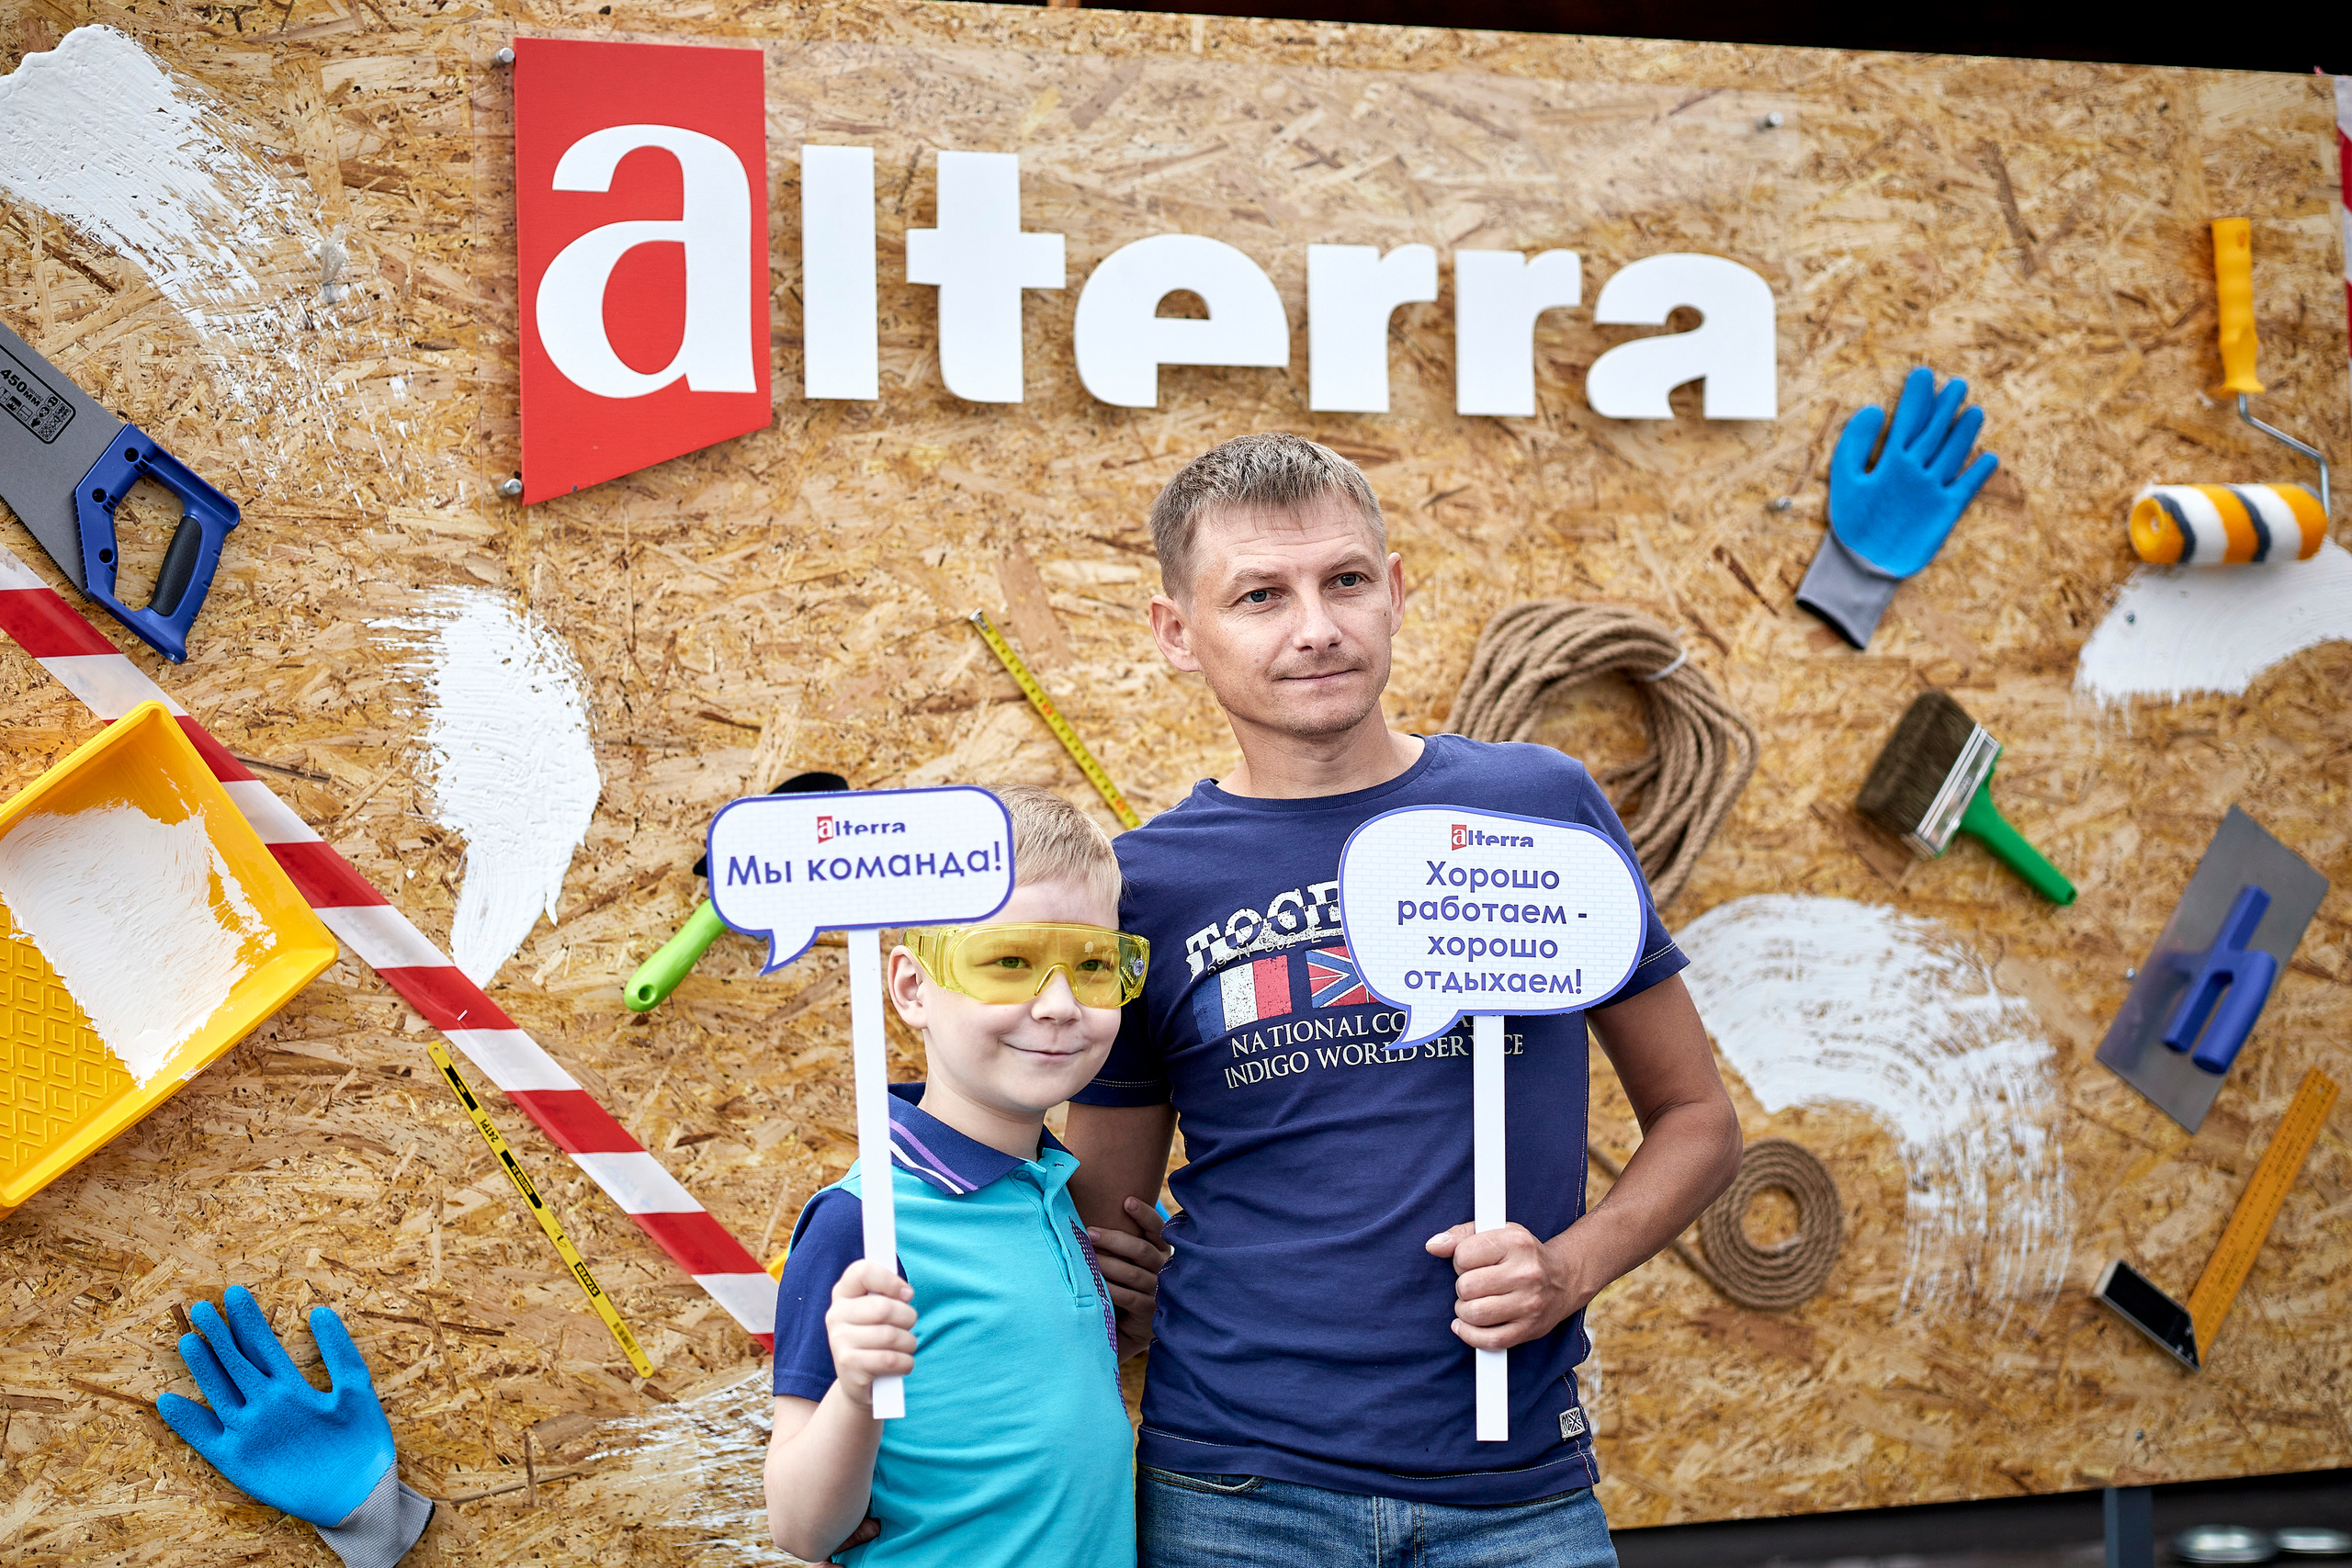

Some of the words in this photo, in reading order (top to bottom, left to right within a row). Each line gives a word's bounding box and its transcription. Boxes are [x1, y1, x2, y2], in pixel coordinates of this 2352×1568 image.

[536, 122, 1780, 421] alterra
[817, 817, 906, 841] alterra
[1452, 825, 1534, 850] alterra
[727, 855, 792, 886] Мы
[808, 841, 1001, 882] команда!
[1426, 861, 1560, 893] Хорошо
[1397, 896, 1566, 925] работаем
[1427, 935, 1558, 963] хорошо
[1404, 969, 1582, 995] отдыхаем!
[1231, 1014, 1370, 1058] NATIONAL
[1224, 1051, 1310, 1089] INDIGO
[1315, 1041, 1418, 1069] WORLD
[576, 1263, 599, 1296] STAYER
